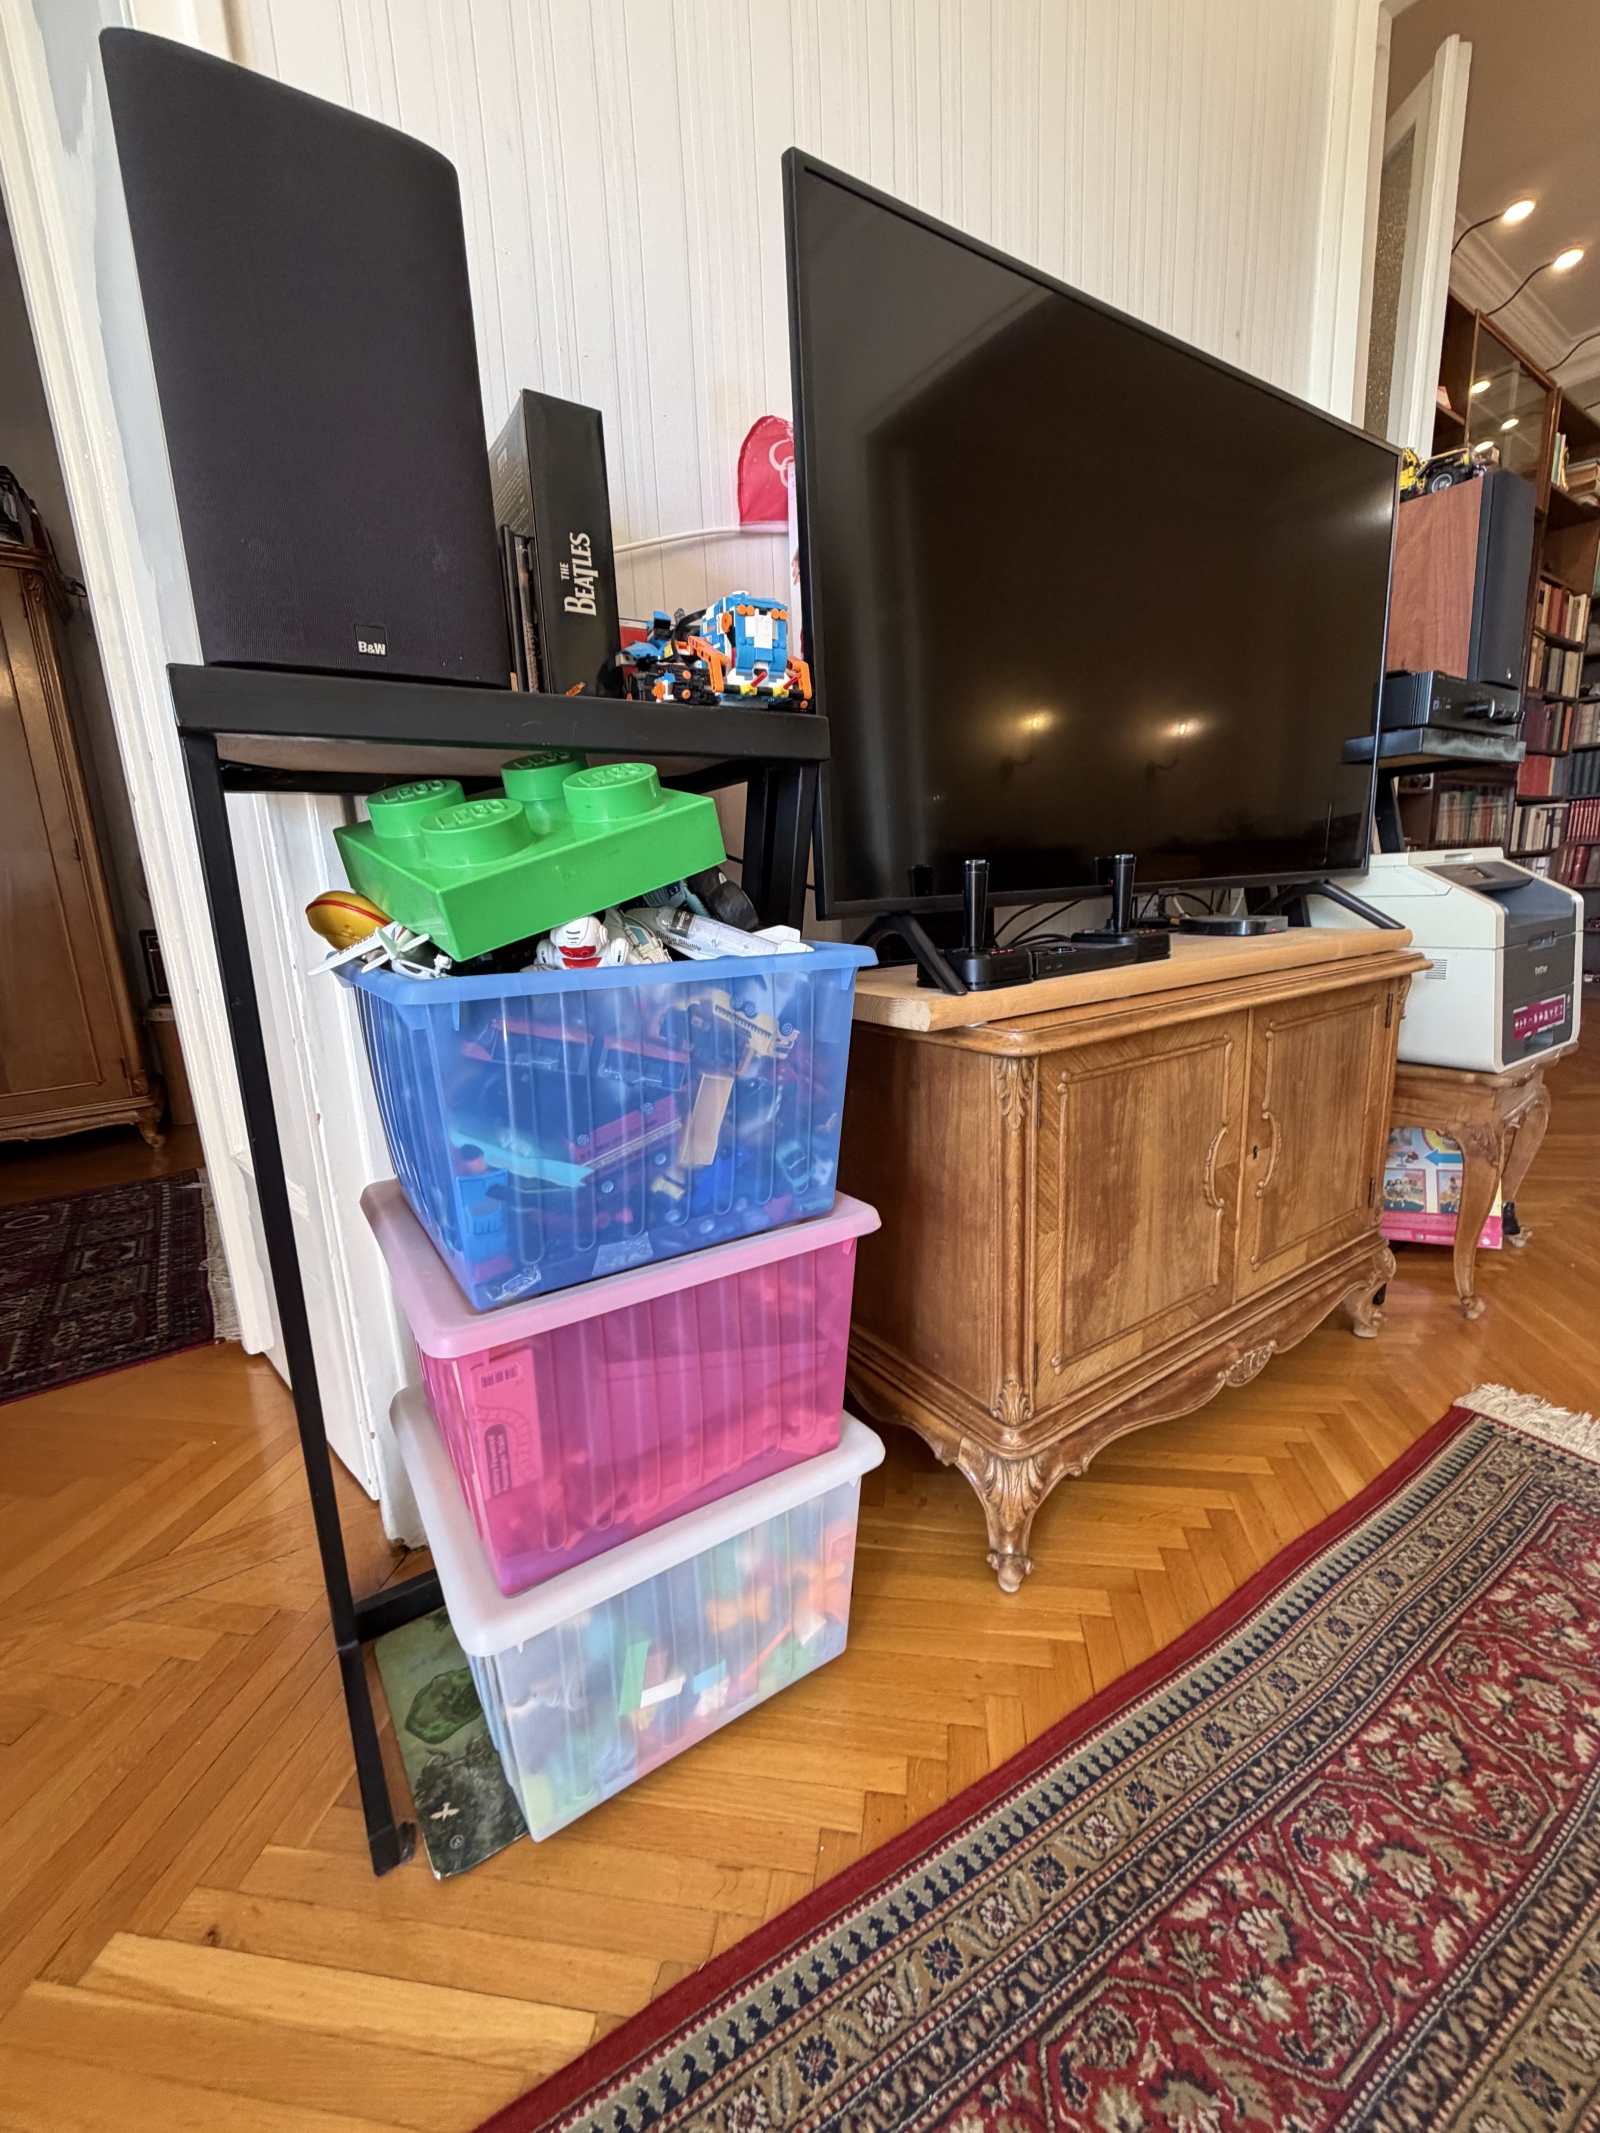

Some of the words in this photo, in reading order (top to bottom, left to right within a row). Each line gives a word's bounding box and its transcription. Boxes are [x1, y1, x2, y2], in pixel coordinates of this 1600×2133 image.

[560, 562, 570, 580] THE
[564, 531, 599, 616] BEATLES
[358, 641, 386, 656] B&W
[578, 764, 643, 788] LEGO
[381, 779, 446, 804] LEGO
[435, 800, 508, 830] LEGO
